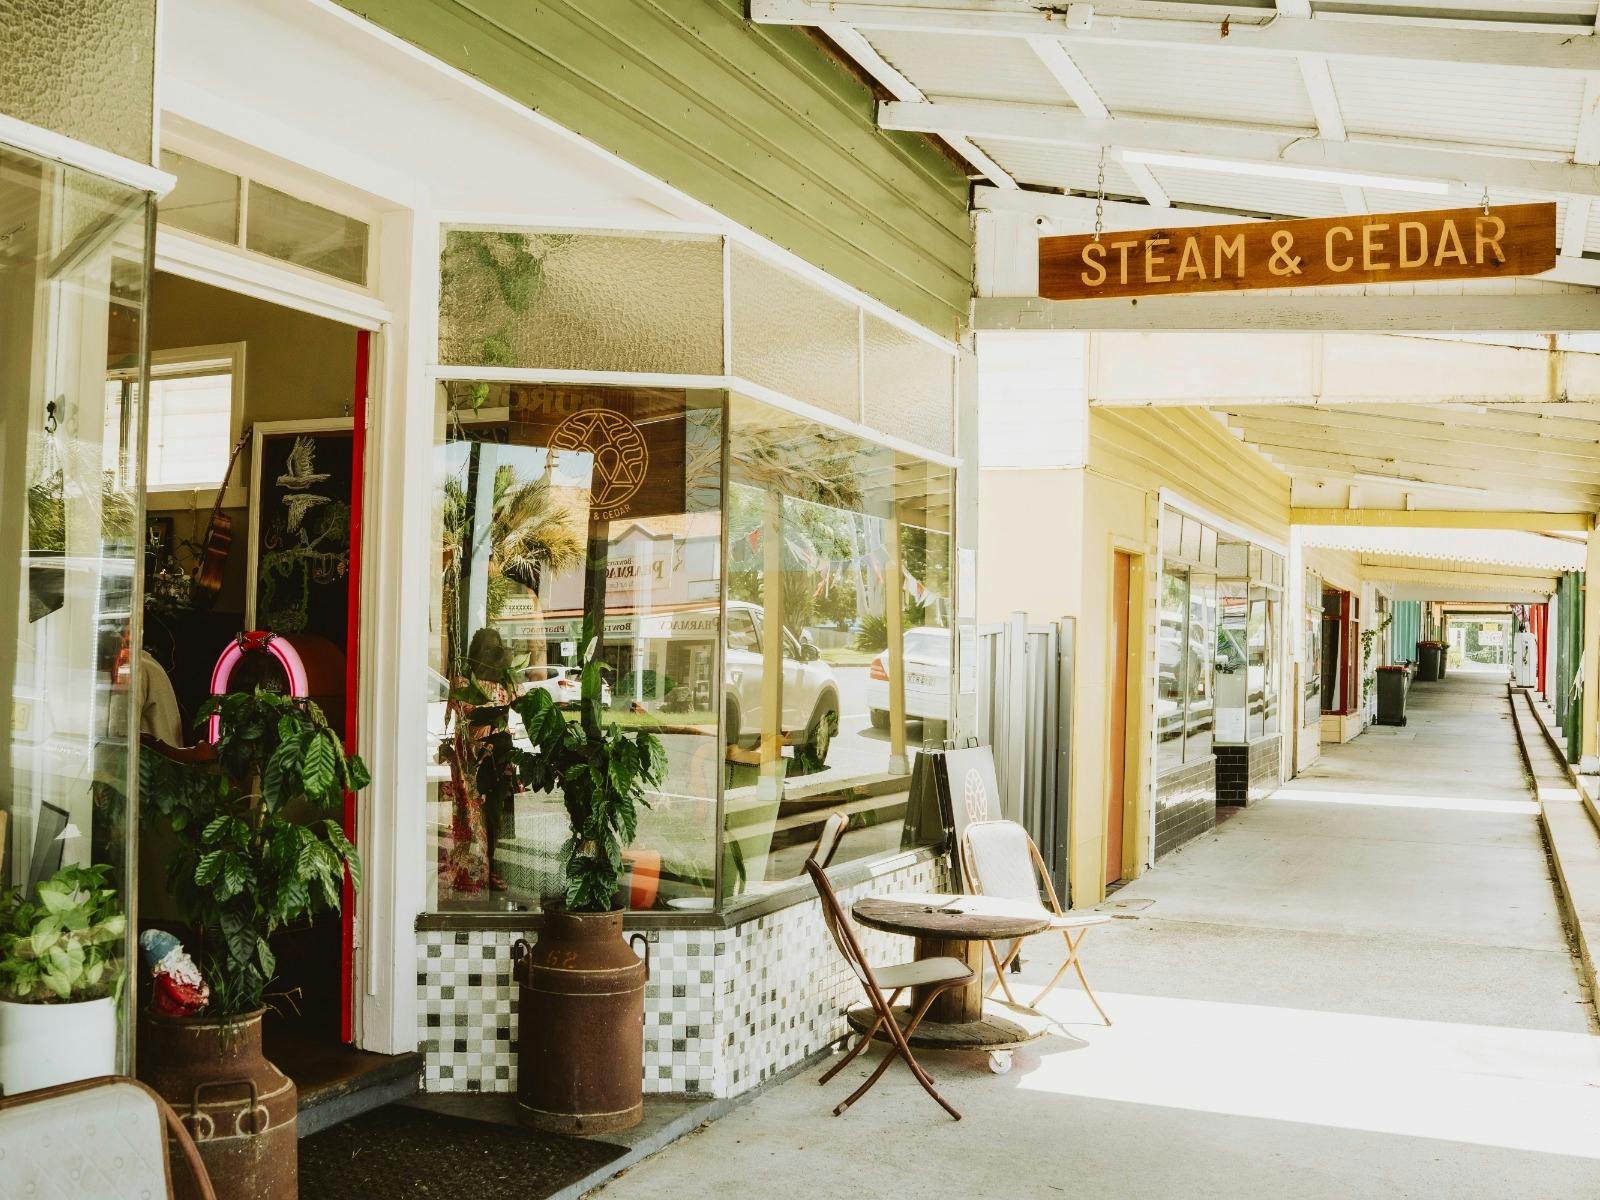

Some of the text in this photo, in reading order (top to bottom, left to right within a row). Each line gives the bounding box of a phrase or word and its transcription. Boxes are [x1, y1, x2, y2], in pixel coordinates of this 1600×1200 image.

[1081, 216, 1507, 287] STEAM & CEDAR
[602, 504, 632, 520] CEDAR
